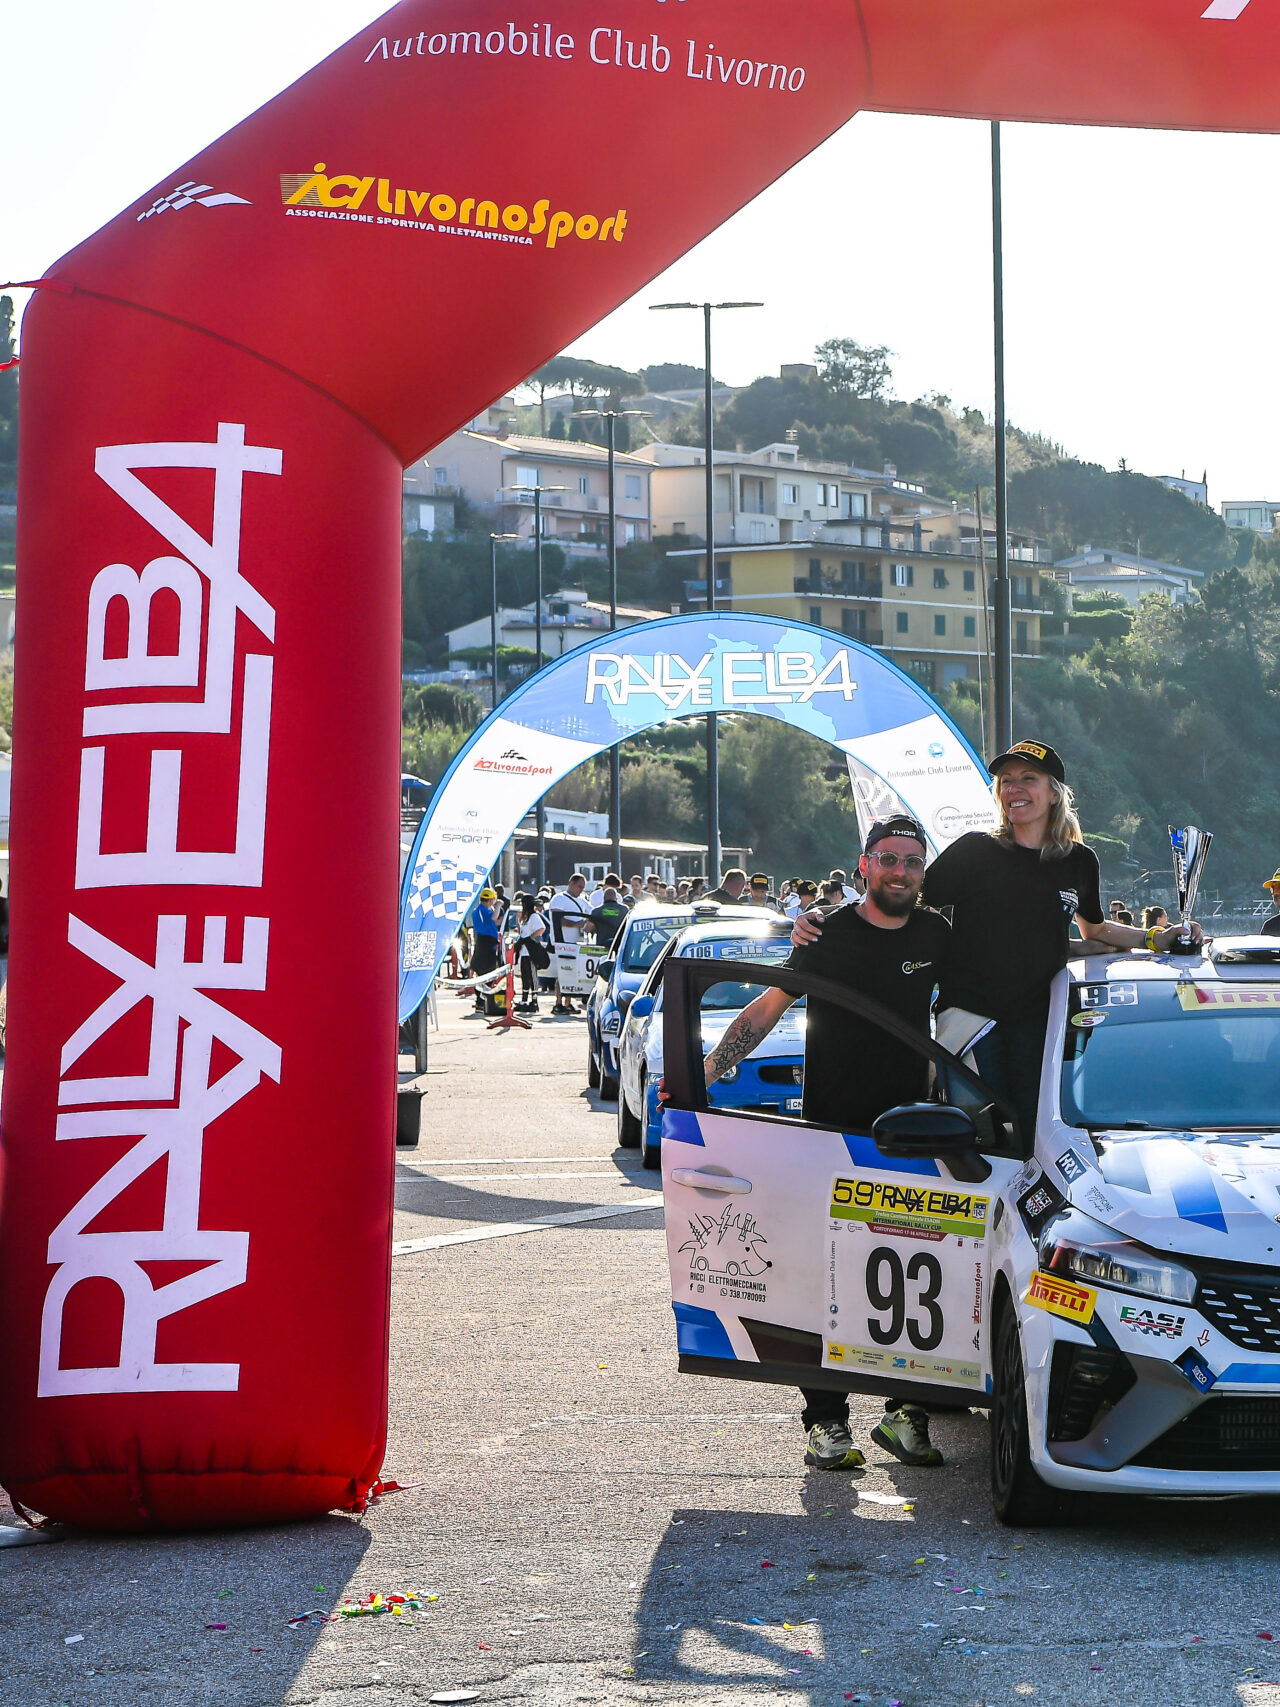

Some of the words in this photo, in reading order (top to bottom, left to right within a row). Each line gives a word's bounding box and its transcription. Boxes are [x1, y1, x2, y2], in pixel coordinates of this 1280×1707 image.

[363, 22, 575, 63] Automobile
[588, 27, 672, 73] Club
[685, 39, 807, 92] Livorno
[285, 208, 374, 224] ASSOCIAZIONE
[376, 215, 436, 233] SPORTIVA
[438, 223, 534, 246] DILETTANTISTICA
[74, 422, 284, 891] ELBA
[721, 649, 859, 705] ELBA
[441, 833, 494, 845] SPORT
[891, 829, 916, 837] THOR
[635, 921, 653, 931] 105
[689, 945, 711, 958] 106
[1085, 984, 1135, 1007] 93
[1059, 1153, 1083, 1179] HRX
[927, 1191, 972, 1217] ELBA
[872, 1217, 914, 1228] INTERNATIONAL
[689, 1271, 706, 1283] RICCI
[708, 1274, 767, 1292] ELETTROMECCANICA
[1030, 1274, 1090, 1313] PIRELLI
[865, 1246, 945, 1352] 93
[933, 1364, 946, 1372] sara
